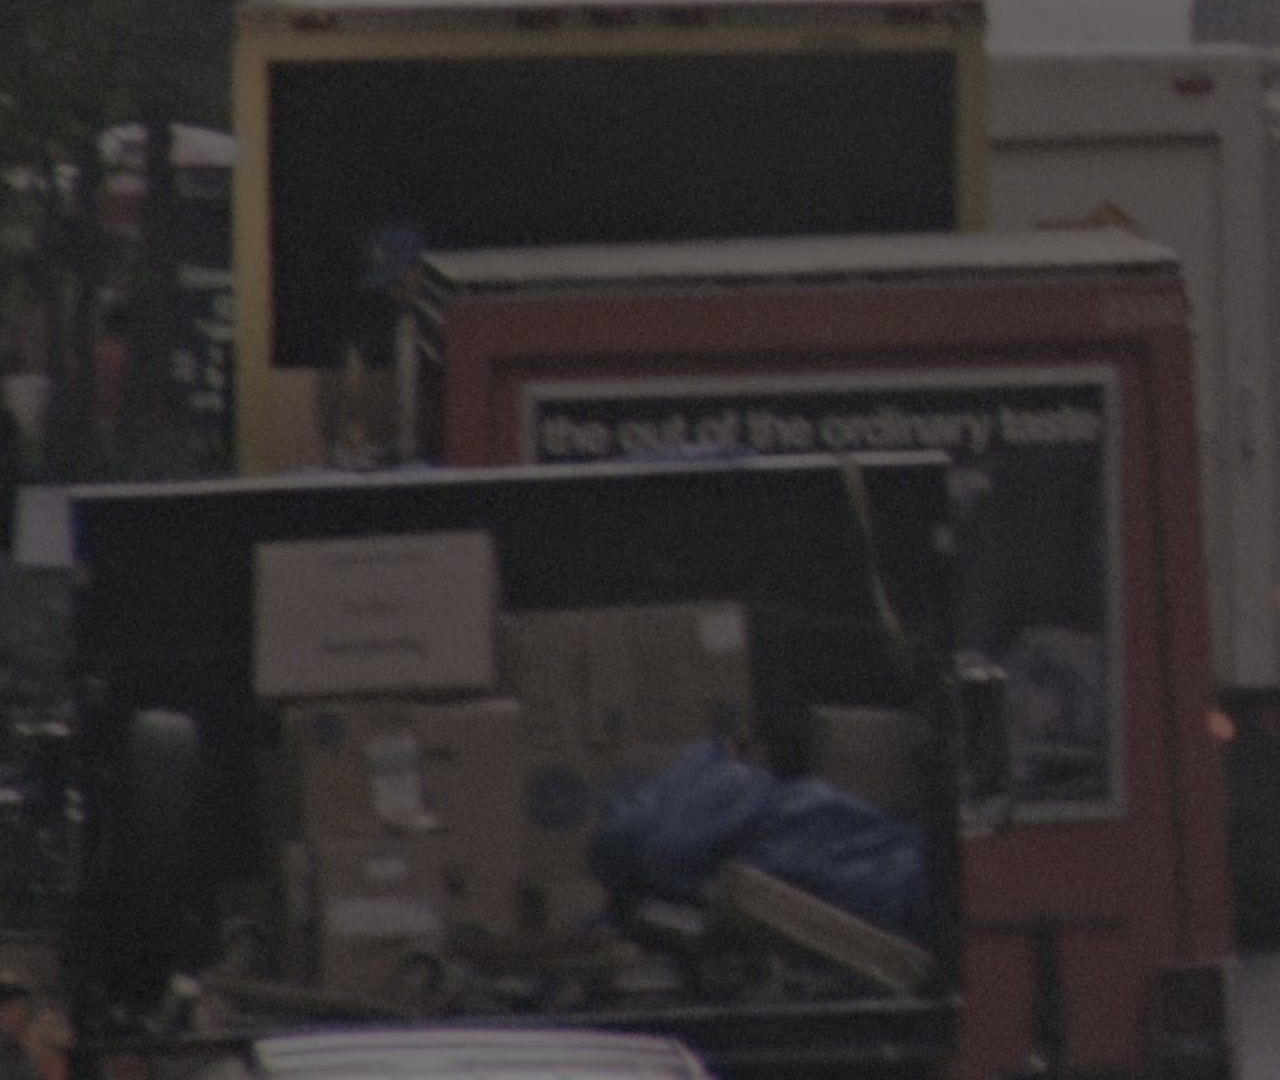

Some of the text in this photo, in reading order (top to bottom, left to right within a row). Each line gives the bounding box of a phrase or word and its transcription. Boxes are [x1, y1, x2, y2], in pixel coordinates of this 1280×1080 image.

[540, 404, 1100, 456] the out of the ordinary taste
